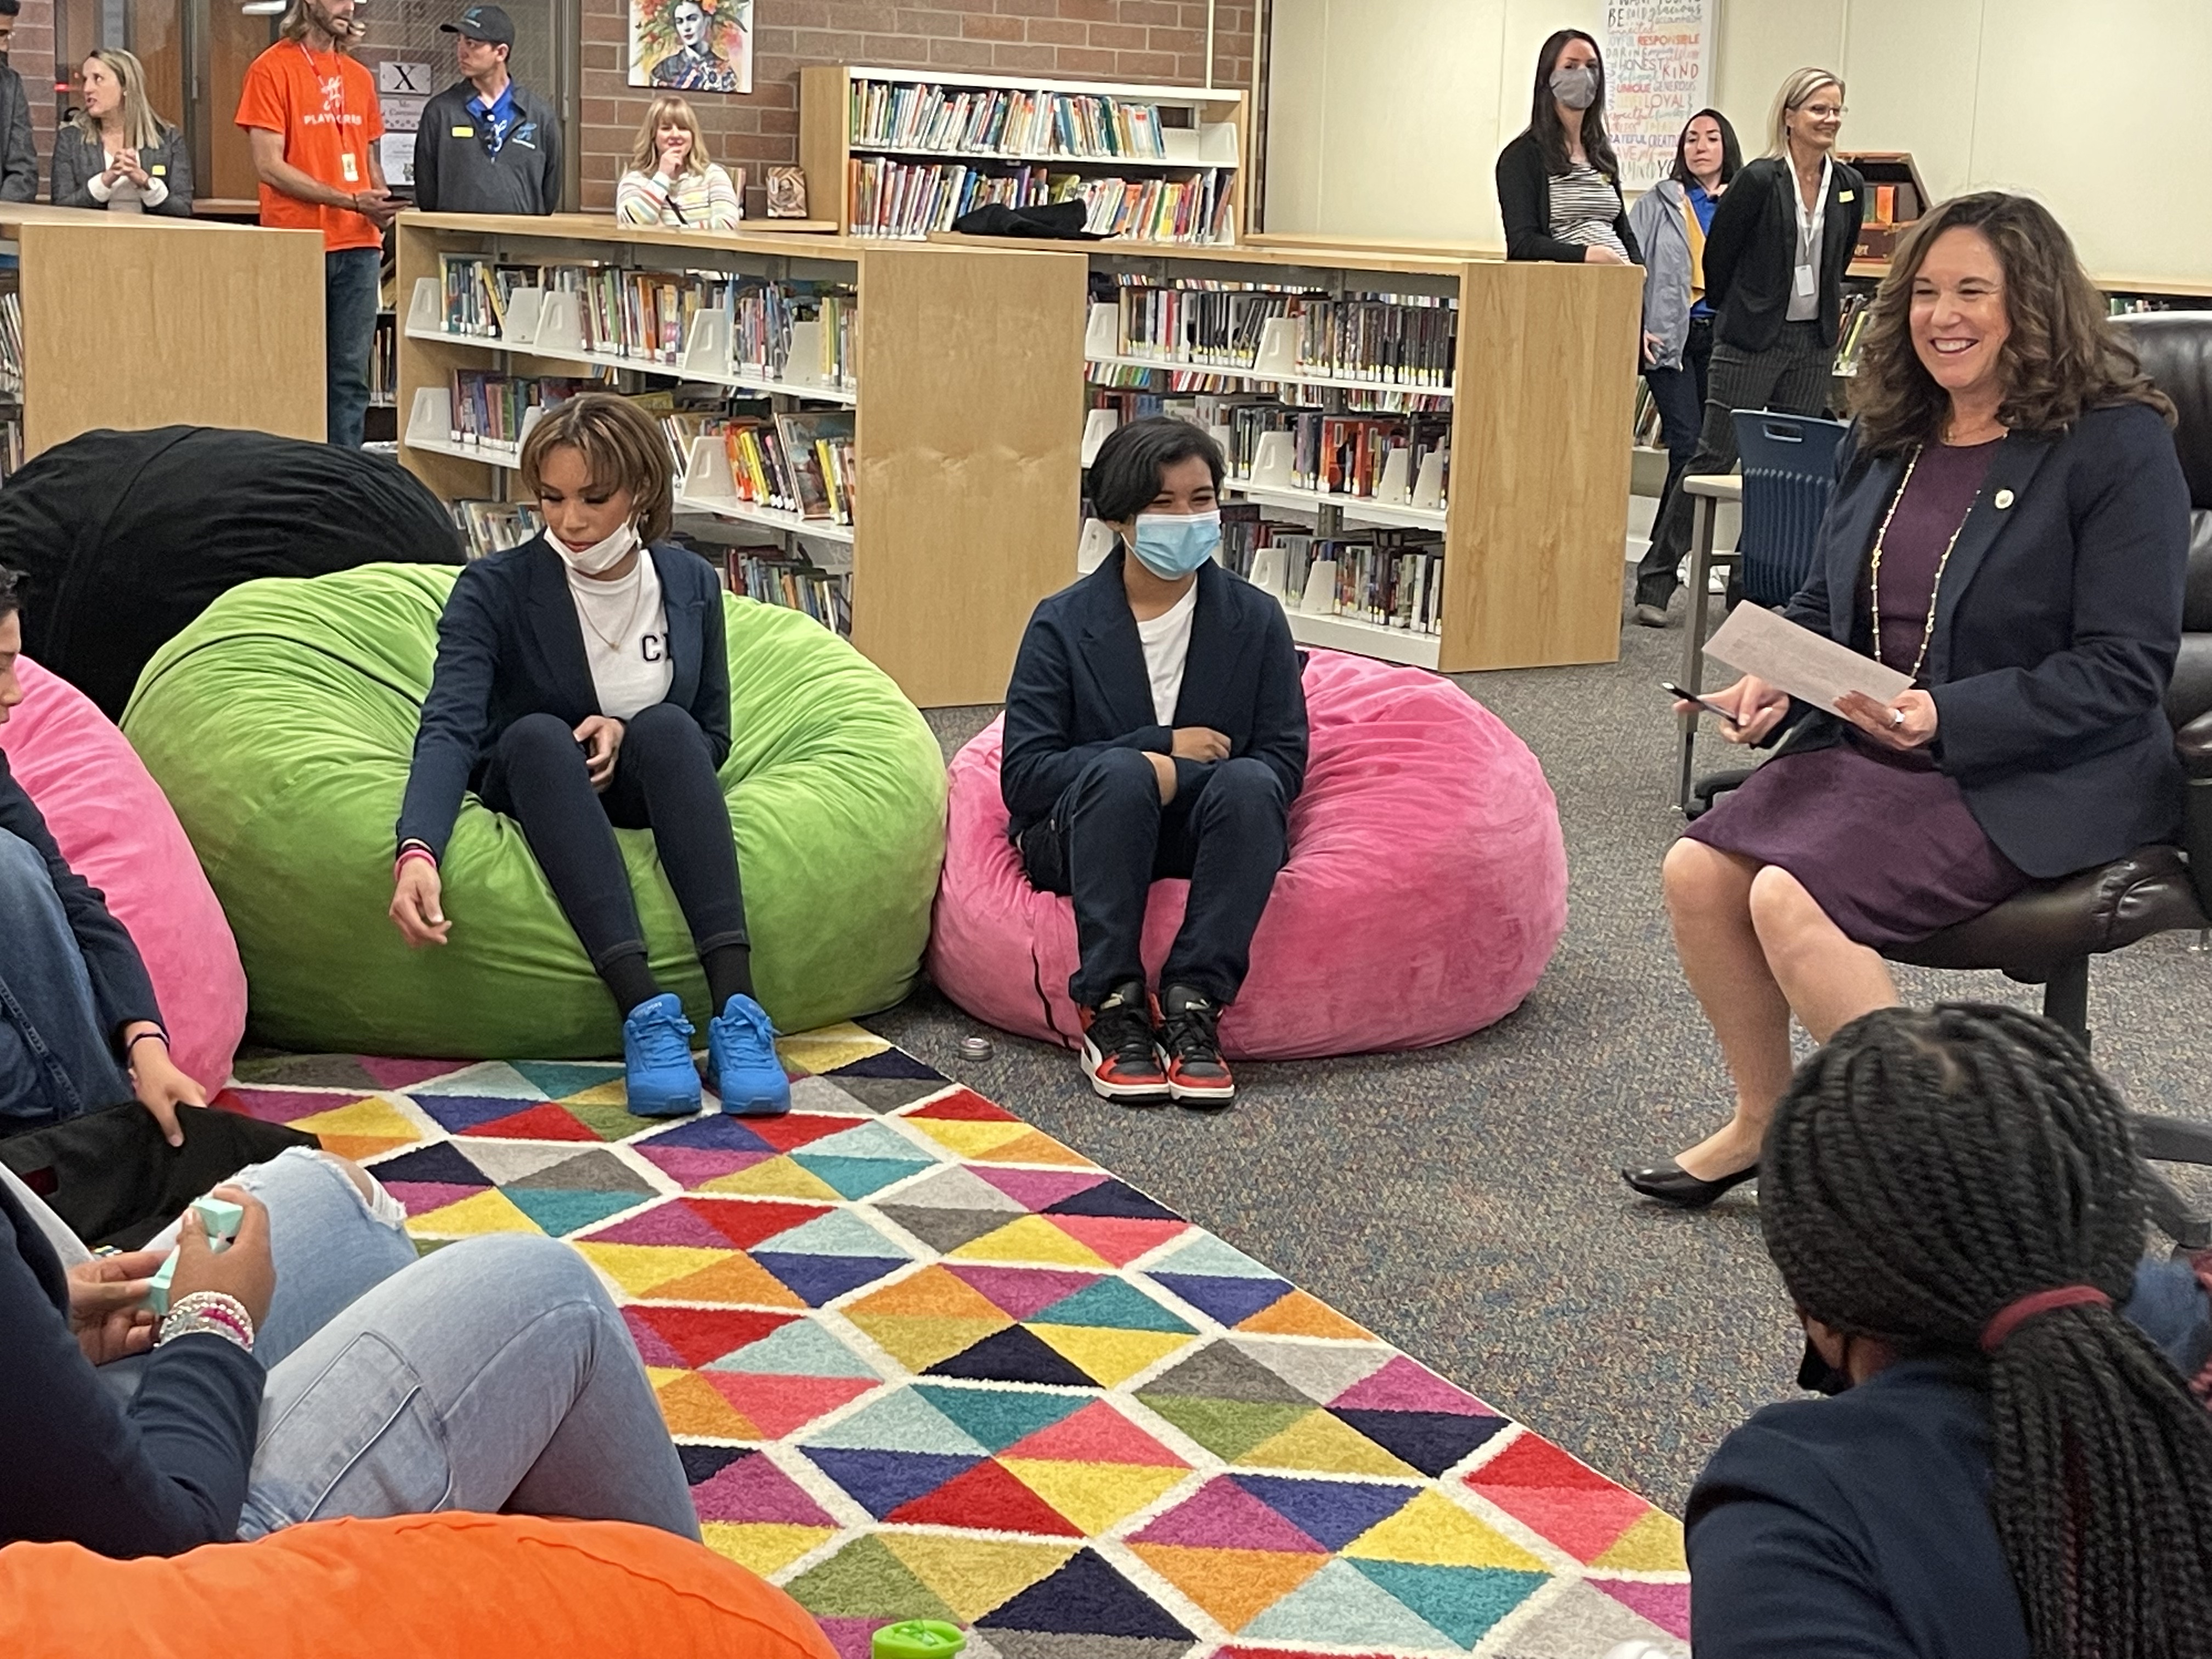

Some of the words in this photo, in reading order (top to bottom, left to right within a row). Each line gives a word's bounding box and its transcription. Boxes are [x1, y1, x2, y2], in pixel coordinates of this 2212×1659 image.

[1609, 8, 1624, 27] BE
[1638, 33, 1700, 46] RESPONSIBLE
[1619, 54, 1664, 70] HONEST
[393, 64, 418, 92] X
[1662, 61, 1699, 80] KIND
[1645, 94, 1685, 109] LOYAL
[1607, 134, 1647, 145] ATEFUL
